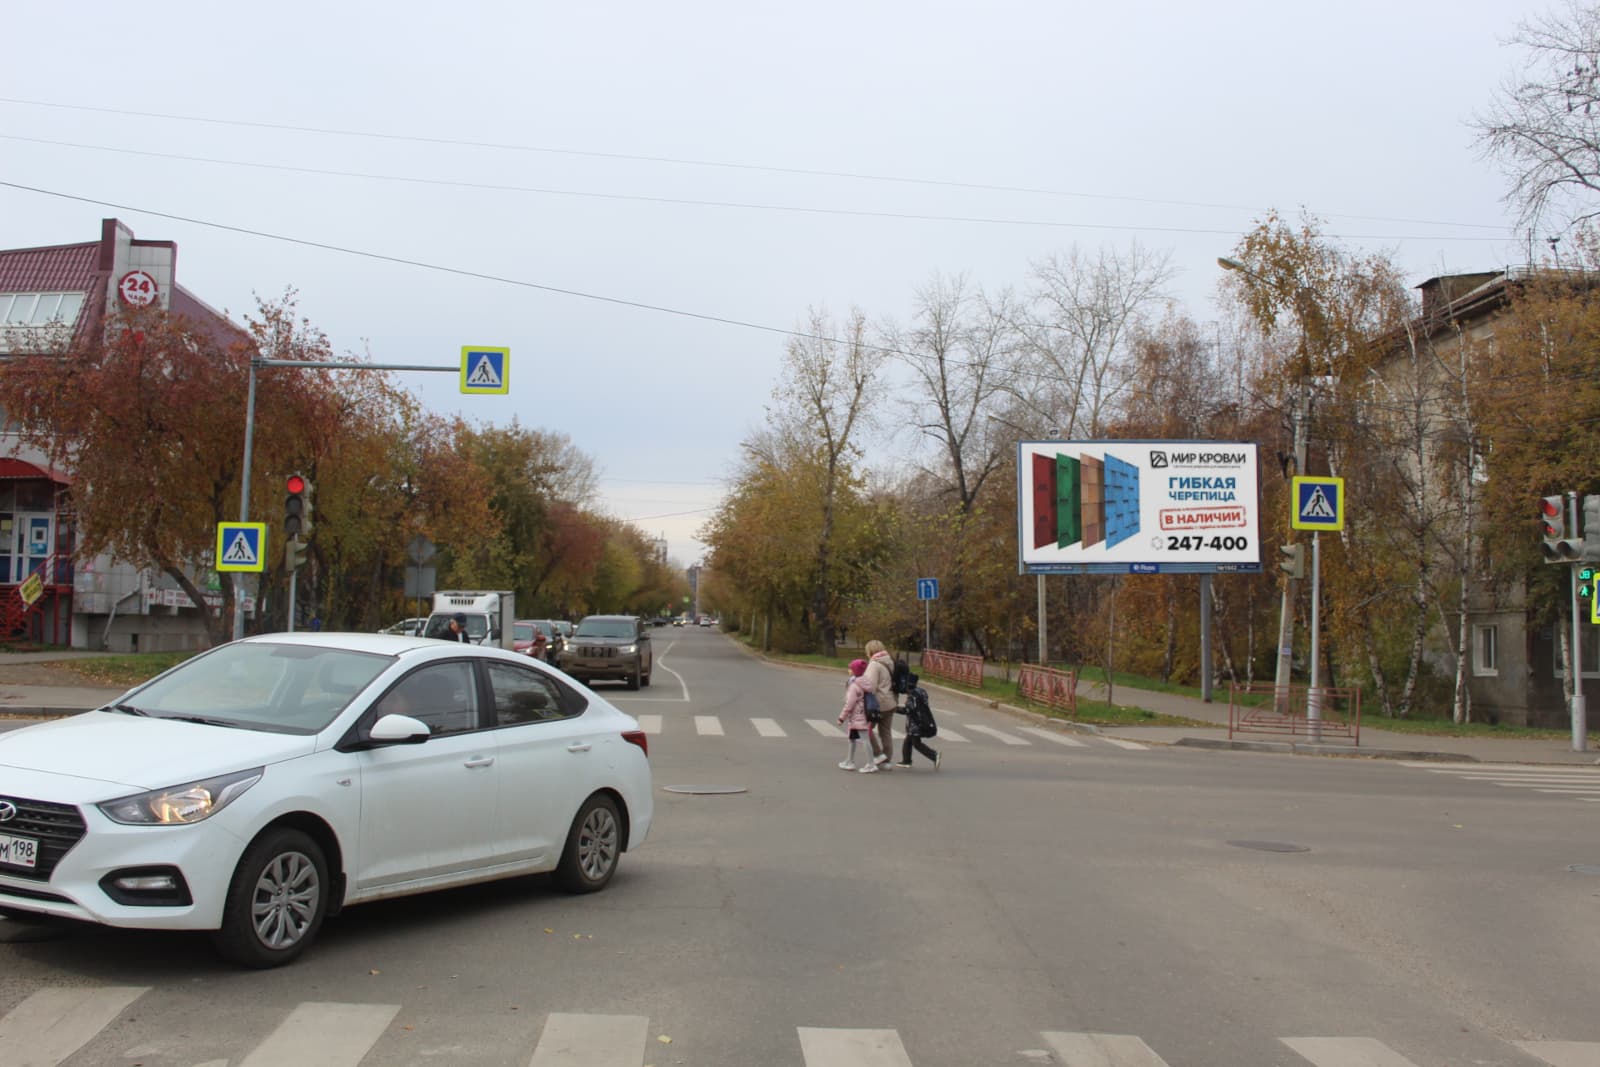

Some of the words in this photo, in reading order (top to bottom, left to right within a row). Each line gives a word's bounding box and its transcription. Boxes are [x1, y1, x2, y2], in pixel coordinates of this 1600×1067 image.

[127, 278, 150, 293] 24
[1171, 453, 1196, 464] МИР
[1199, 453, 1246, 464] КРОВЛИ
[1169, 477, 1236, 489] ГИБКАЯ
[1169, 491, 1236, 502] ЧЕРЕПИЦА
[1165, 515, 1174, 525] В
[1177, 512, 1241, 524] НАЛИЧИИ
[1168, 536, 1248, 551] 247-400
[12, 840, 33, 857] 198
